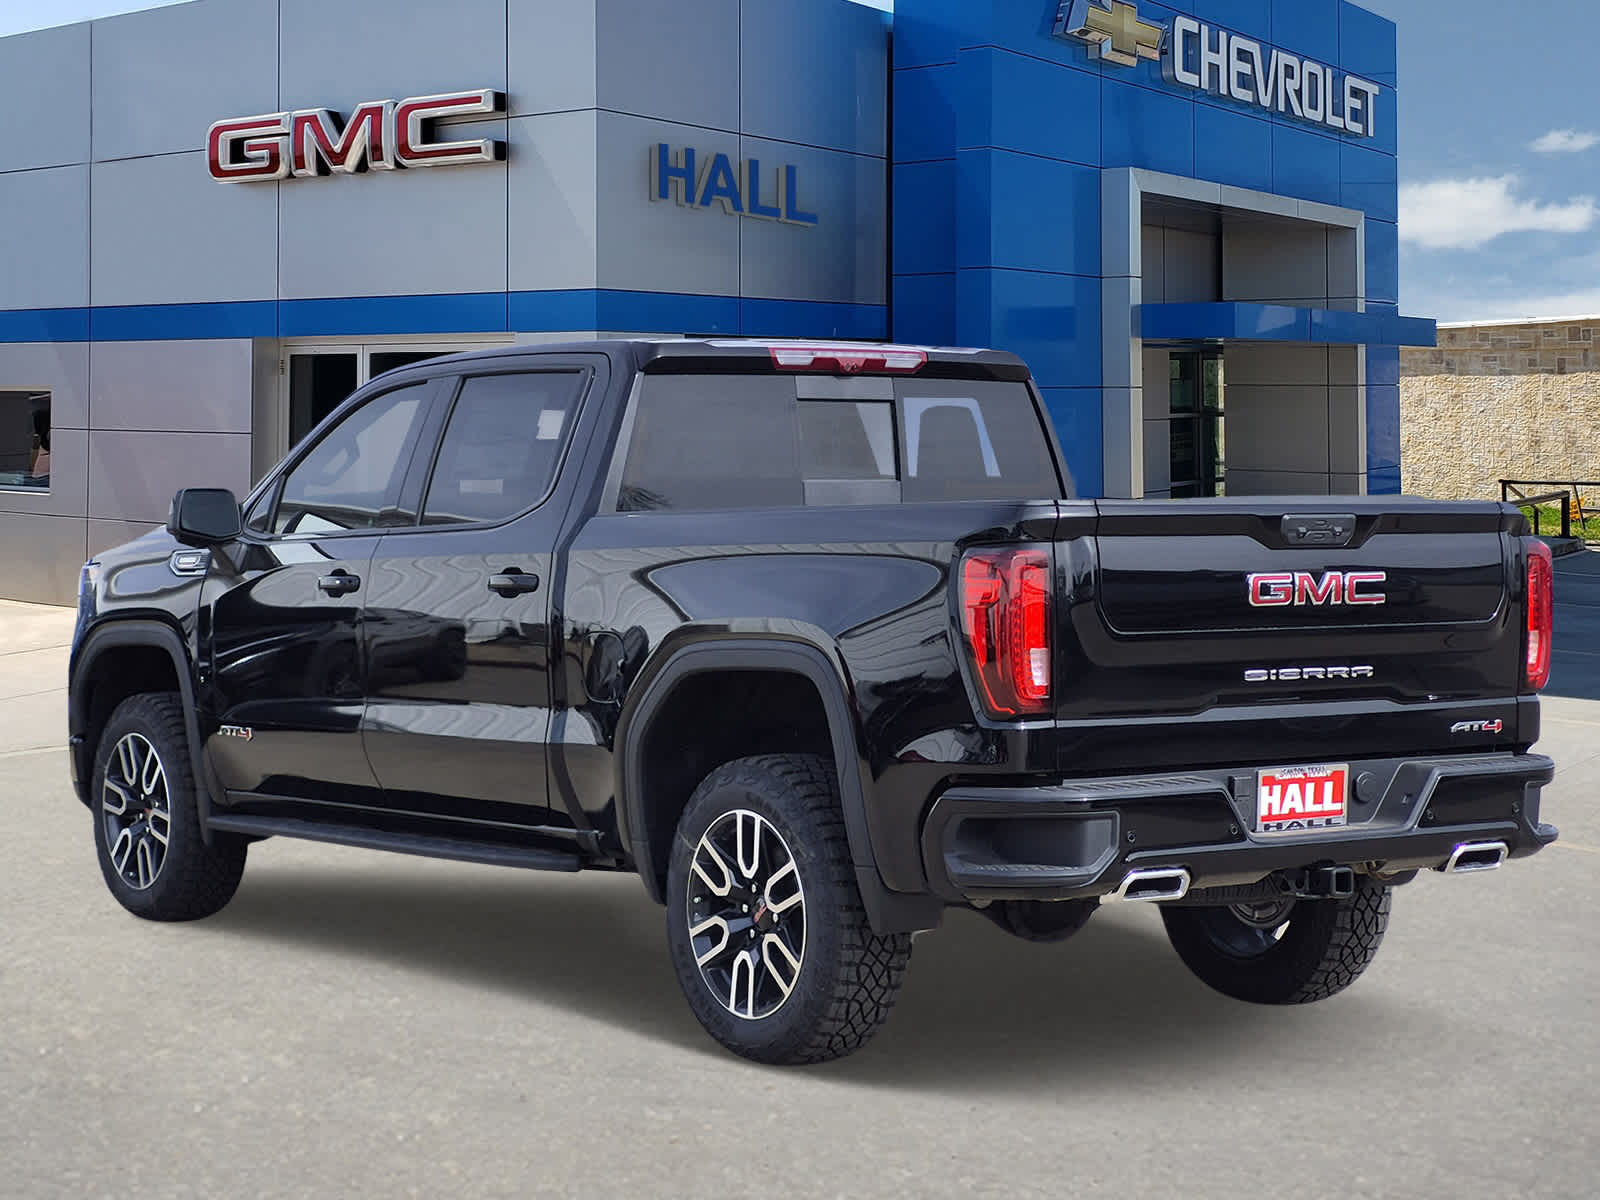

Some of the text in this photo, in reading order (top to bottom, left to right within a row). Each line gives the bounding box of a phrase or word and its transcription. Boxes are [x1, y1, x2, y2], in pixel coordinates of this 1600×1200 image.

[1174, 15, 1380, 137] CHEVROLET
[207, 88, 502, 184] GMC
[652, 142, 819, 226] HALL
[1248, 571, 1386, 606] GMC
[1244, 666, 1374, 681] SIERRA
[1450, 719, 1502, 734] AT4
[1260, 780, 1344, 816] HALL
